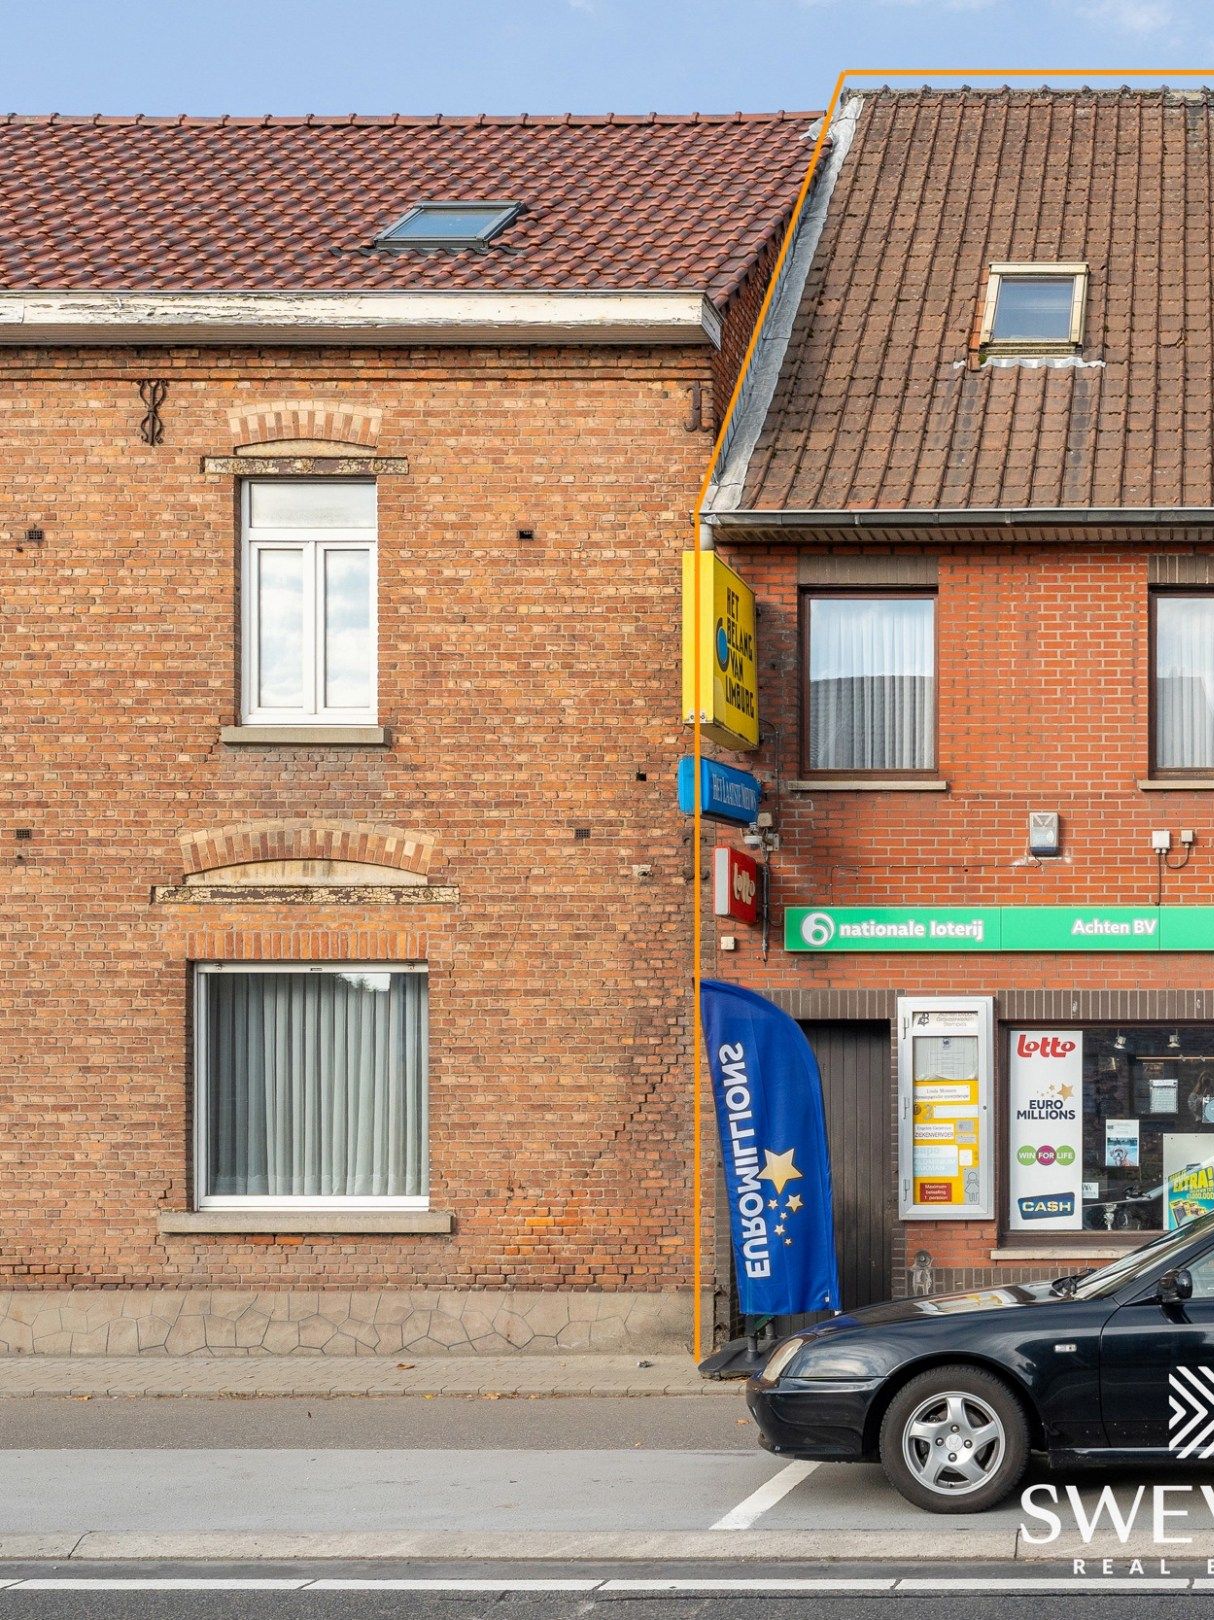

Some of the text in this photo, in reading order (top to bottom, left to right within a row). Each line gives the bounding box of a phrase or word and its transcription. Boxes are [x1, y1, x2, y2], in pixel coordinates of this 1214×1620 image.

[726, 586, 740, 622] HET
[727, 616, 753, 662] BELANG
[730, 651, 744, 682] VAN
[726, 674, 754, 719] LIMBURG
[839, 919, 984, 942] nationale loterij
[1071, 919, 1157, 935] Achten BV
[1016, 1109, 1076, 1120] MILLIONS
[1029, 1099, 1064, 1110] EURO
